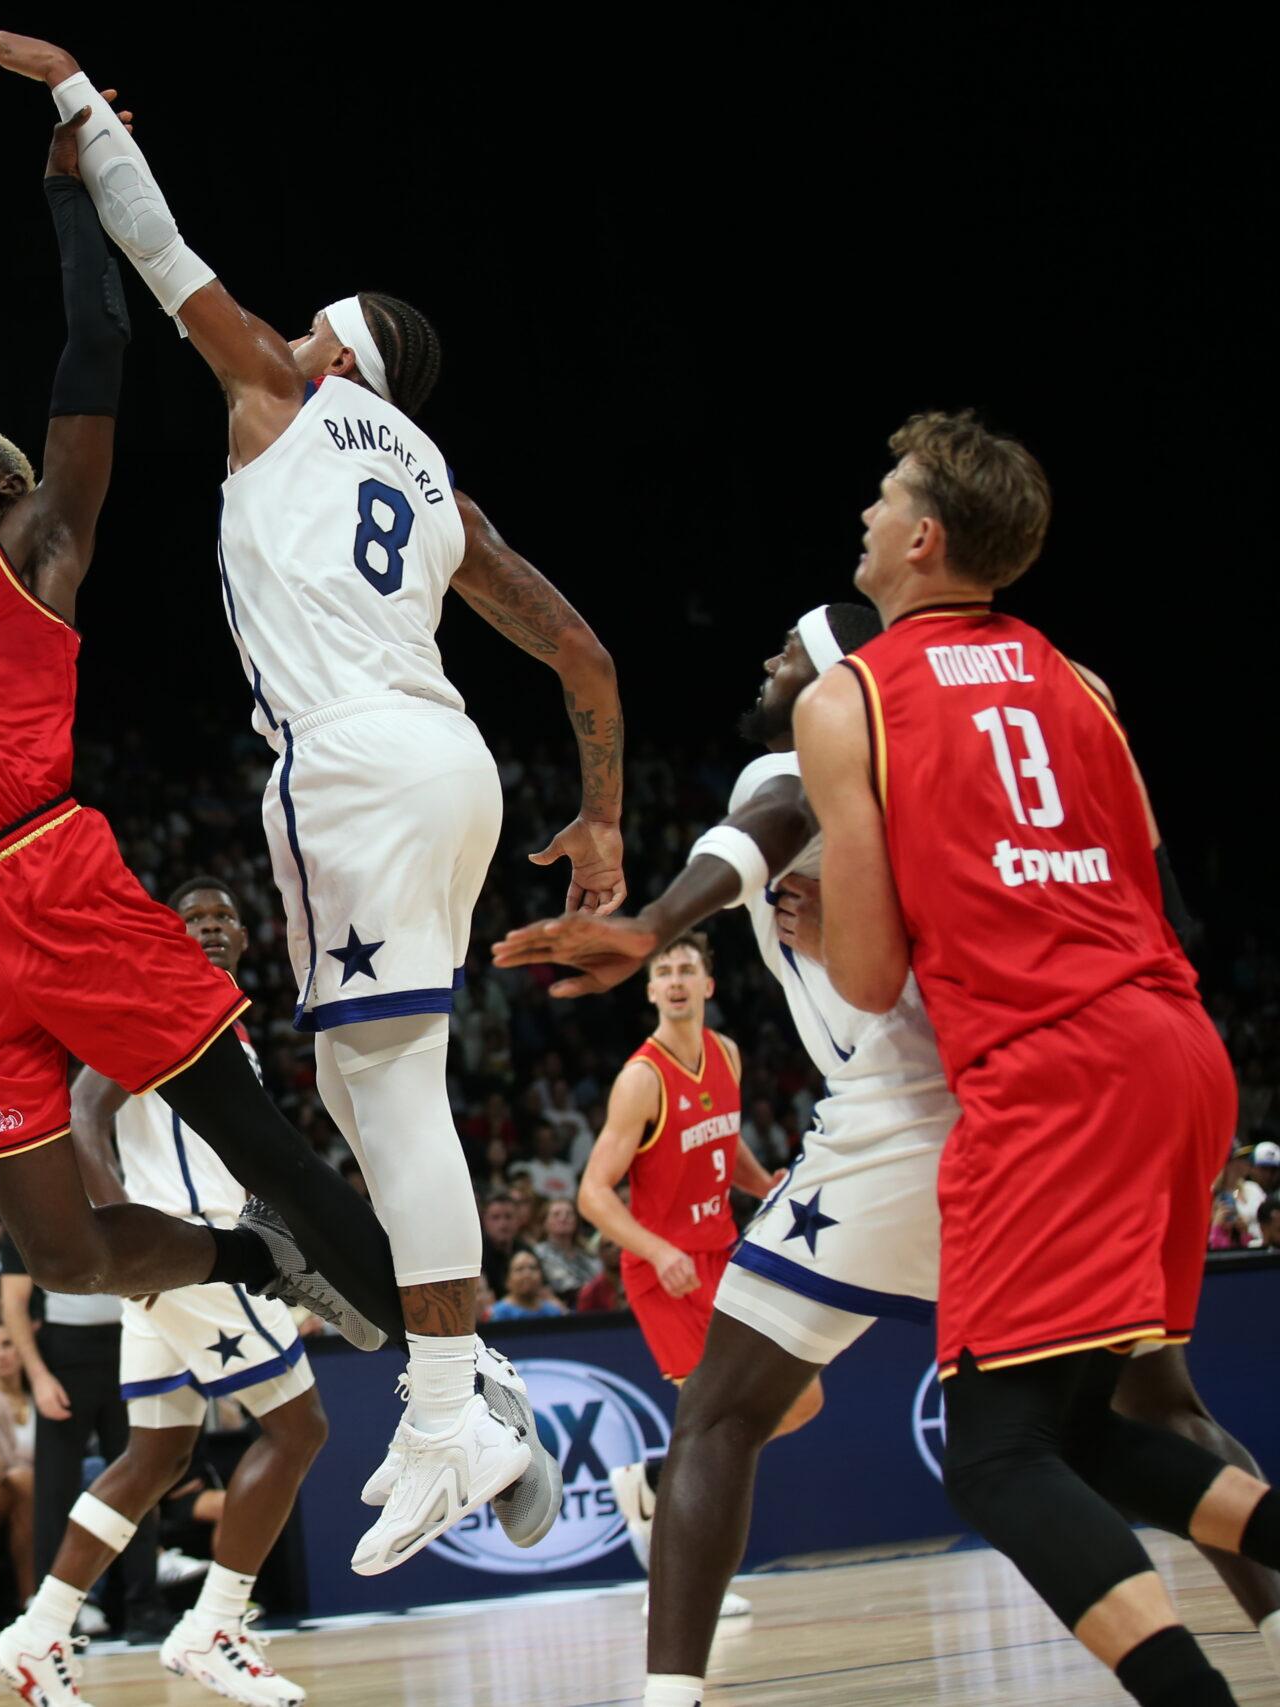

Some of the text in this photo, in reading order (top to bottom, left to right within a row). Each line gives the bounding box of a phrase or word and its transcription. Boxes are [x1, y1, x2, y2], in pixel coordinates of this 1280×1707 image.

[323, 416, 444, 505] BANCHERO
[353, 477, 415, 597] 8
[924, 641, 1036, 687] MORITZ
[971, 706, 1065, 829] 13
[712, 1148, 726, 1183] 9
